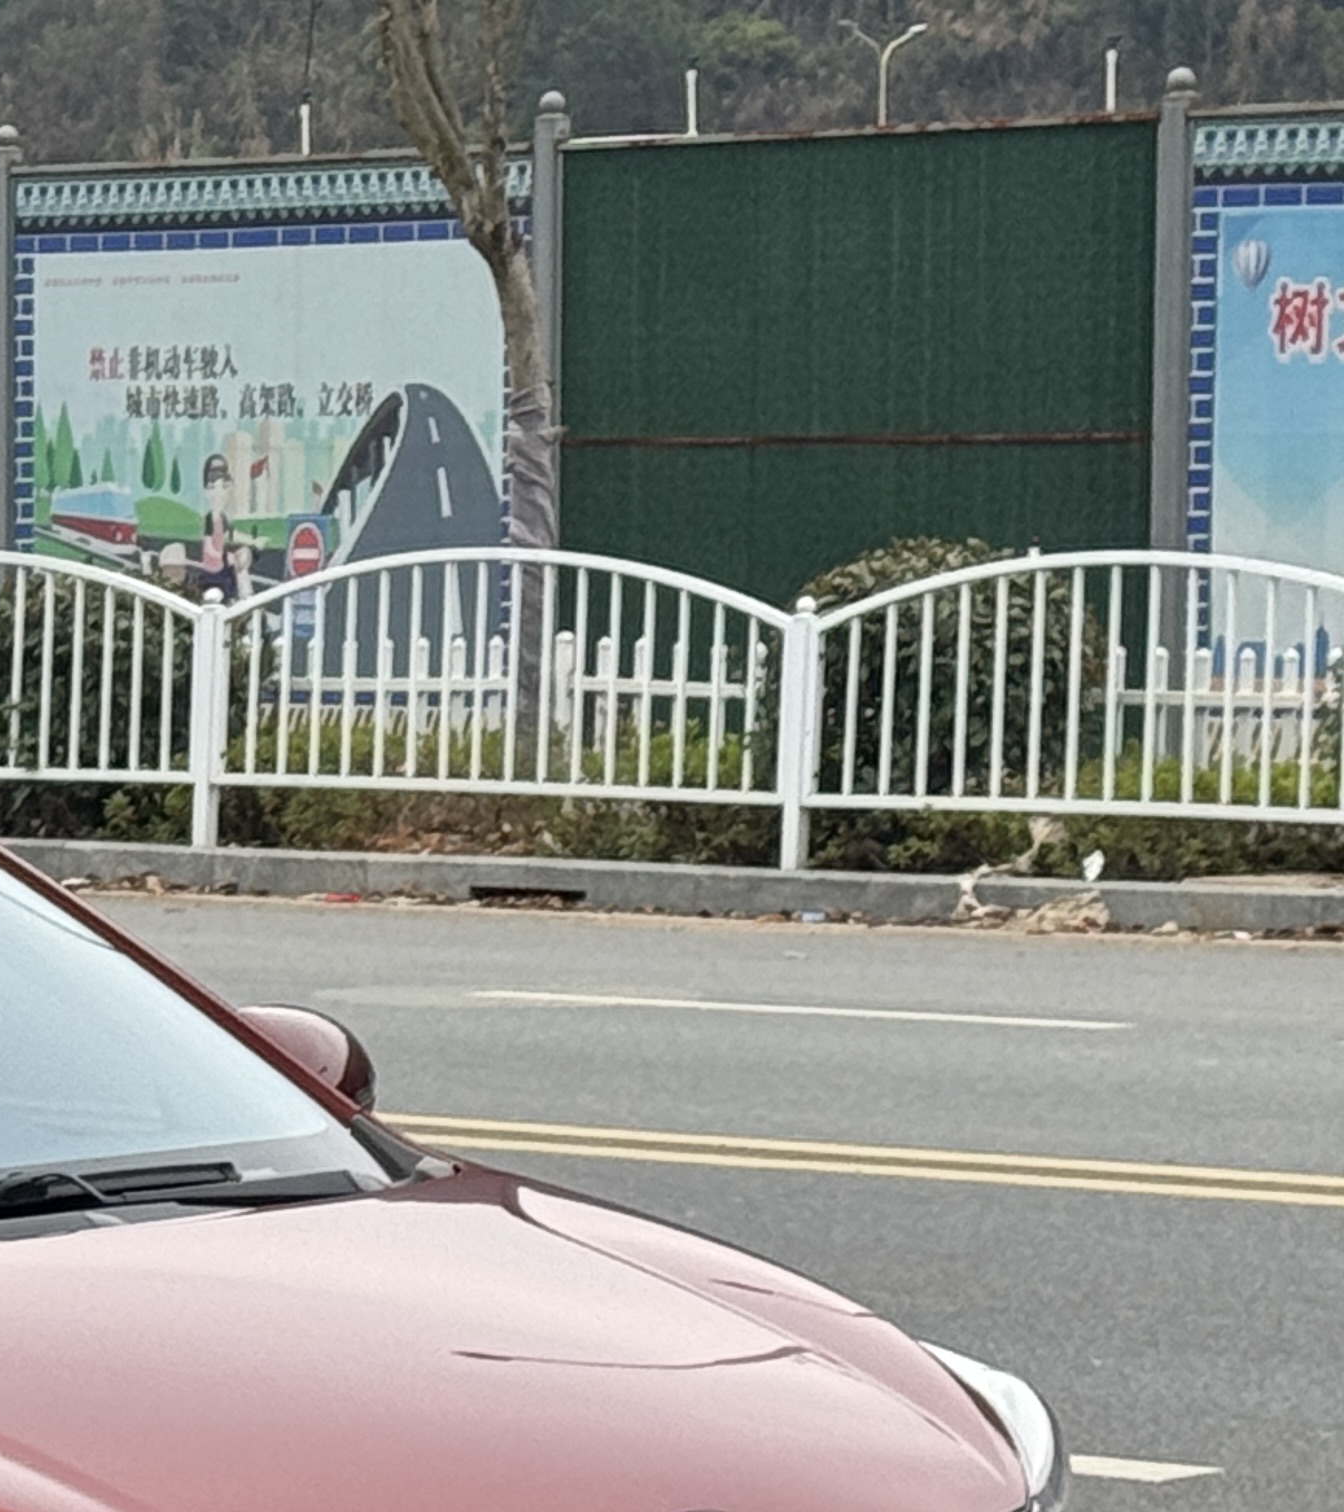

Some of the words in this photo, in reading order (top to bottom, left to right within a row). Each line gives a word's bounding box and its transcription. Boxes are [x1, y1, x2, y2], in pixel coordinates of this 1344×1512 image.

[1272, 281, 1344, 356] 树
[89, 343, 238, 381] 禁止非机动车驶入
